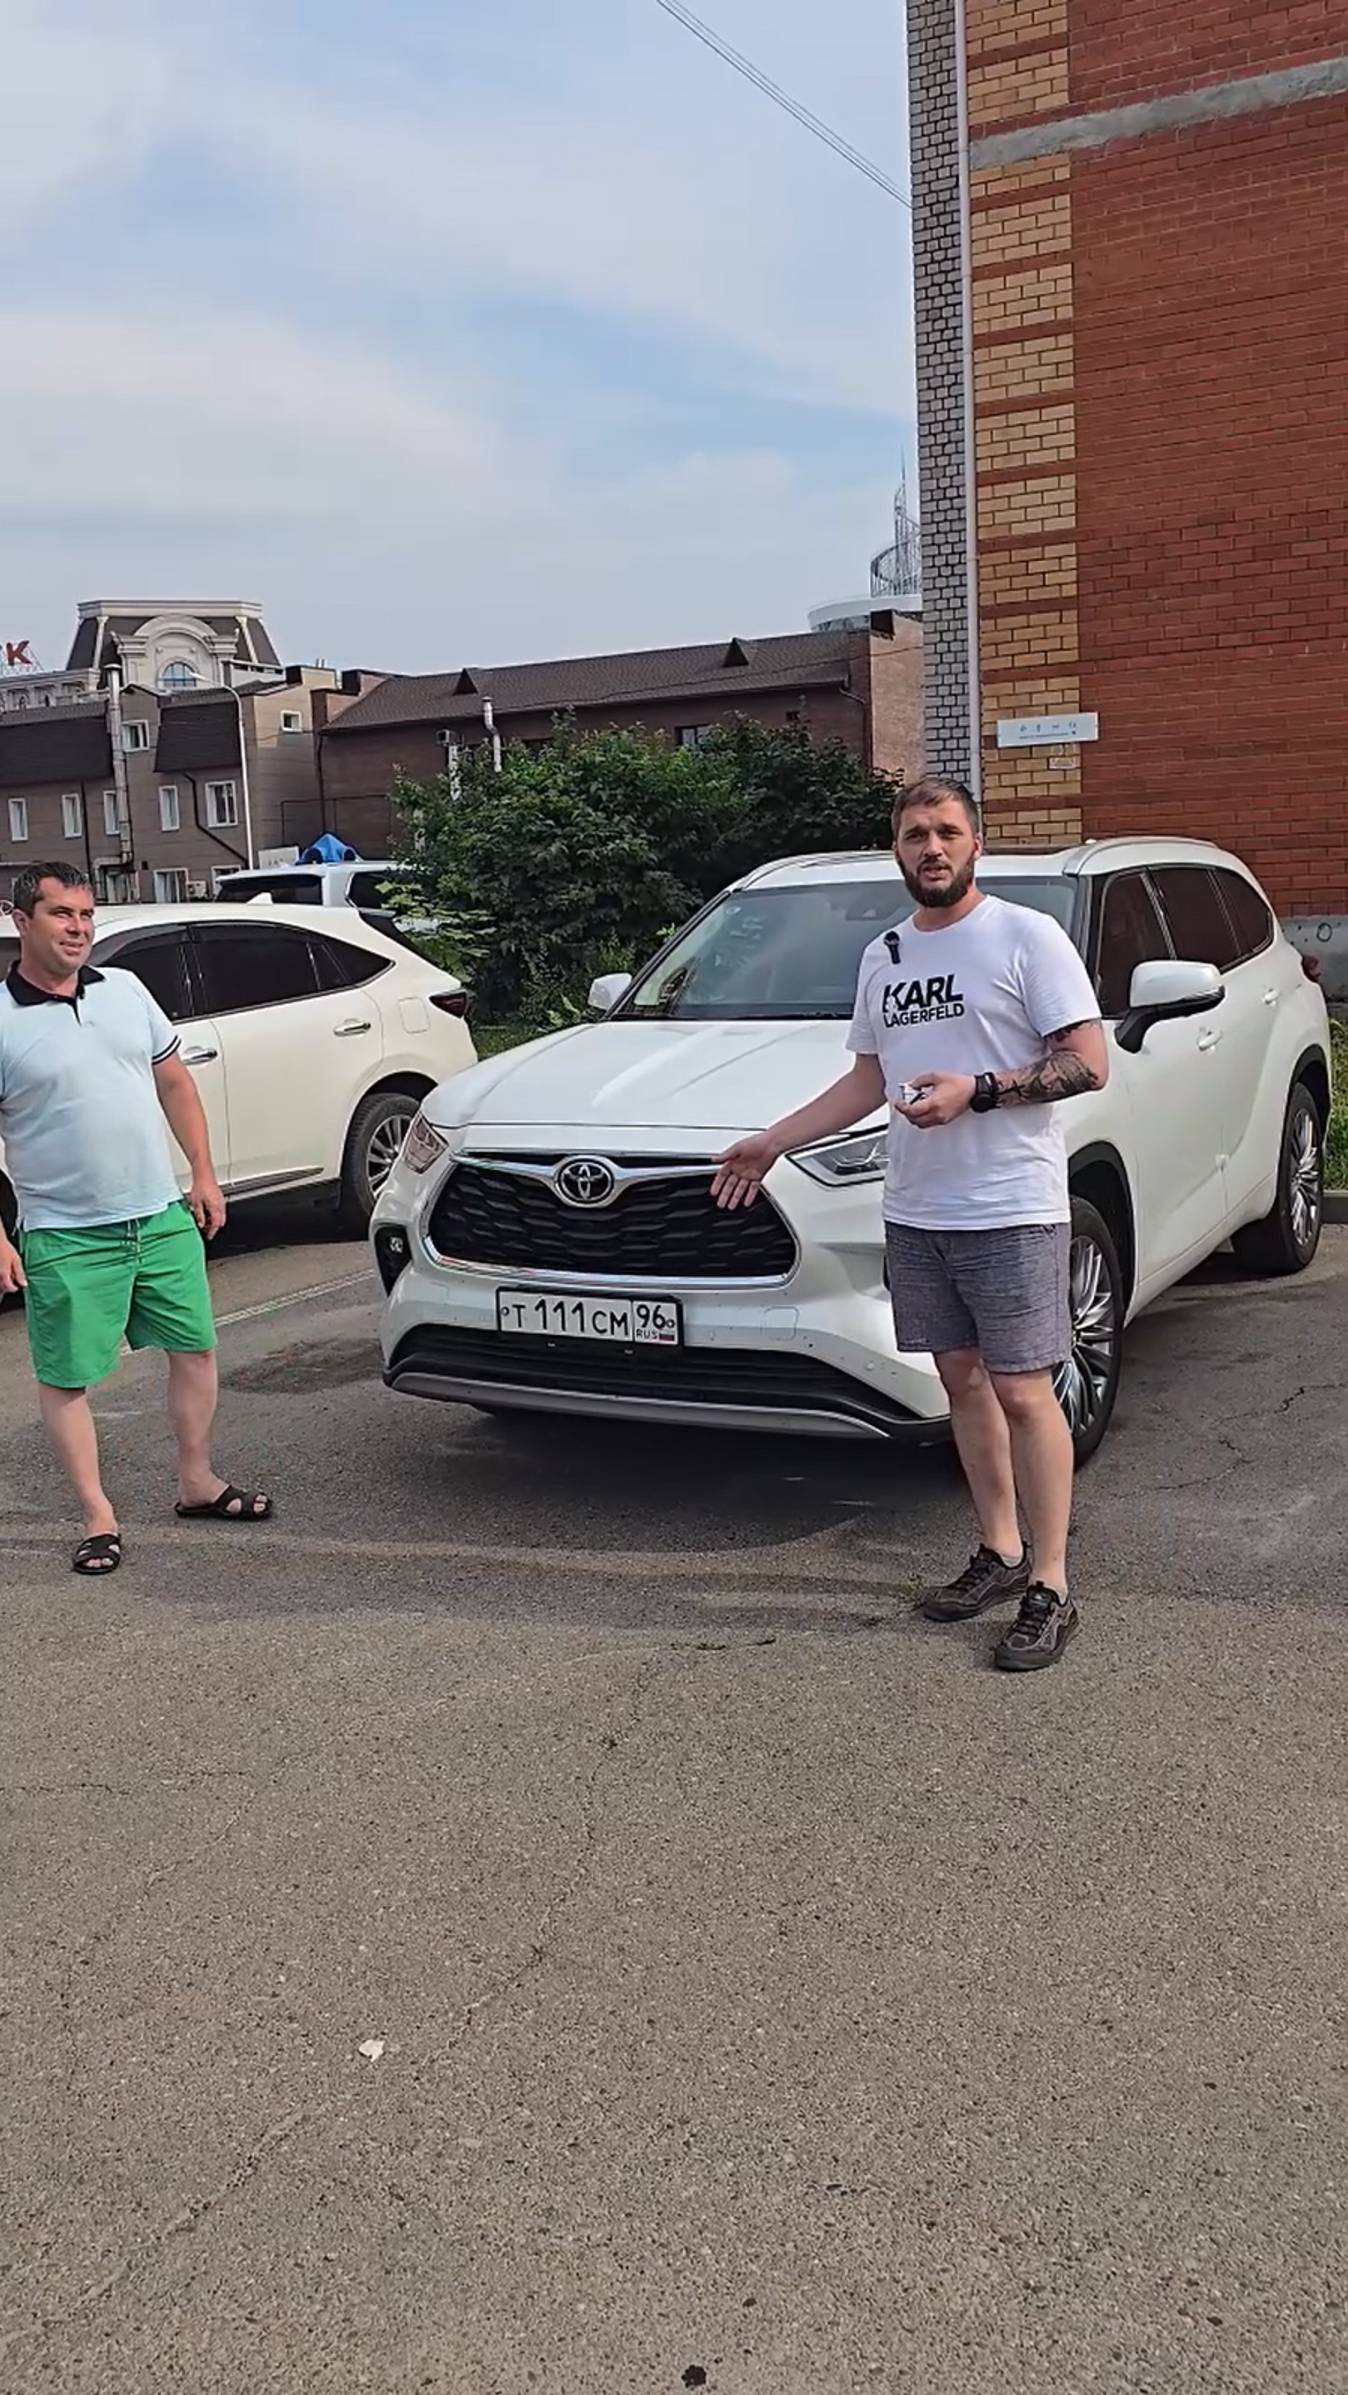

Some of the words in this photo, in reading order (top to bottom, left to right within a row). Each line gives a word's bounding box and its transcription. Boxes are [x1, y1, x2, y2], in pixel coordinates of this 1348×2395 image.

[882, 974, 963, 1013] KARL
[883, 1003, 965, 1028] LAGERFELD
[636, 1304, 666, 1330] 96
[636, 1329, 658, 1340] RUS
